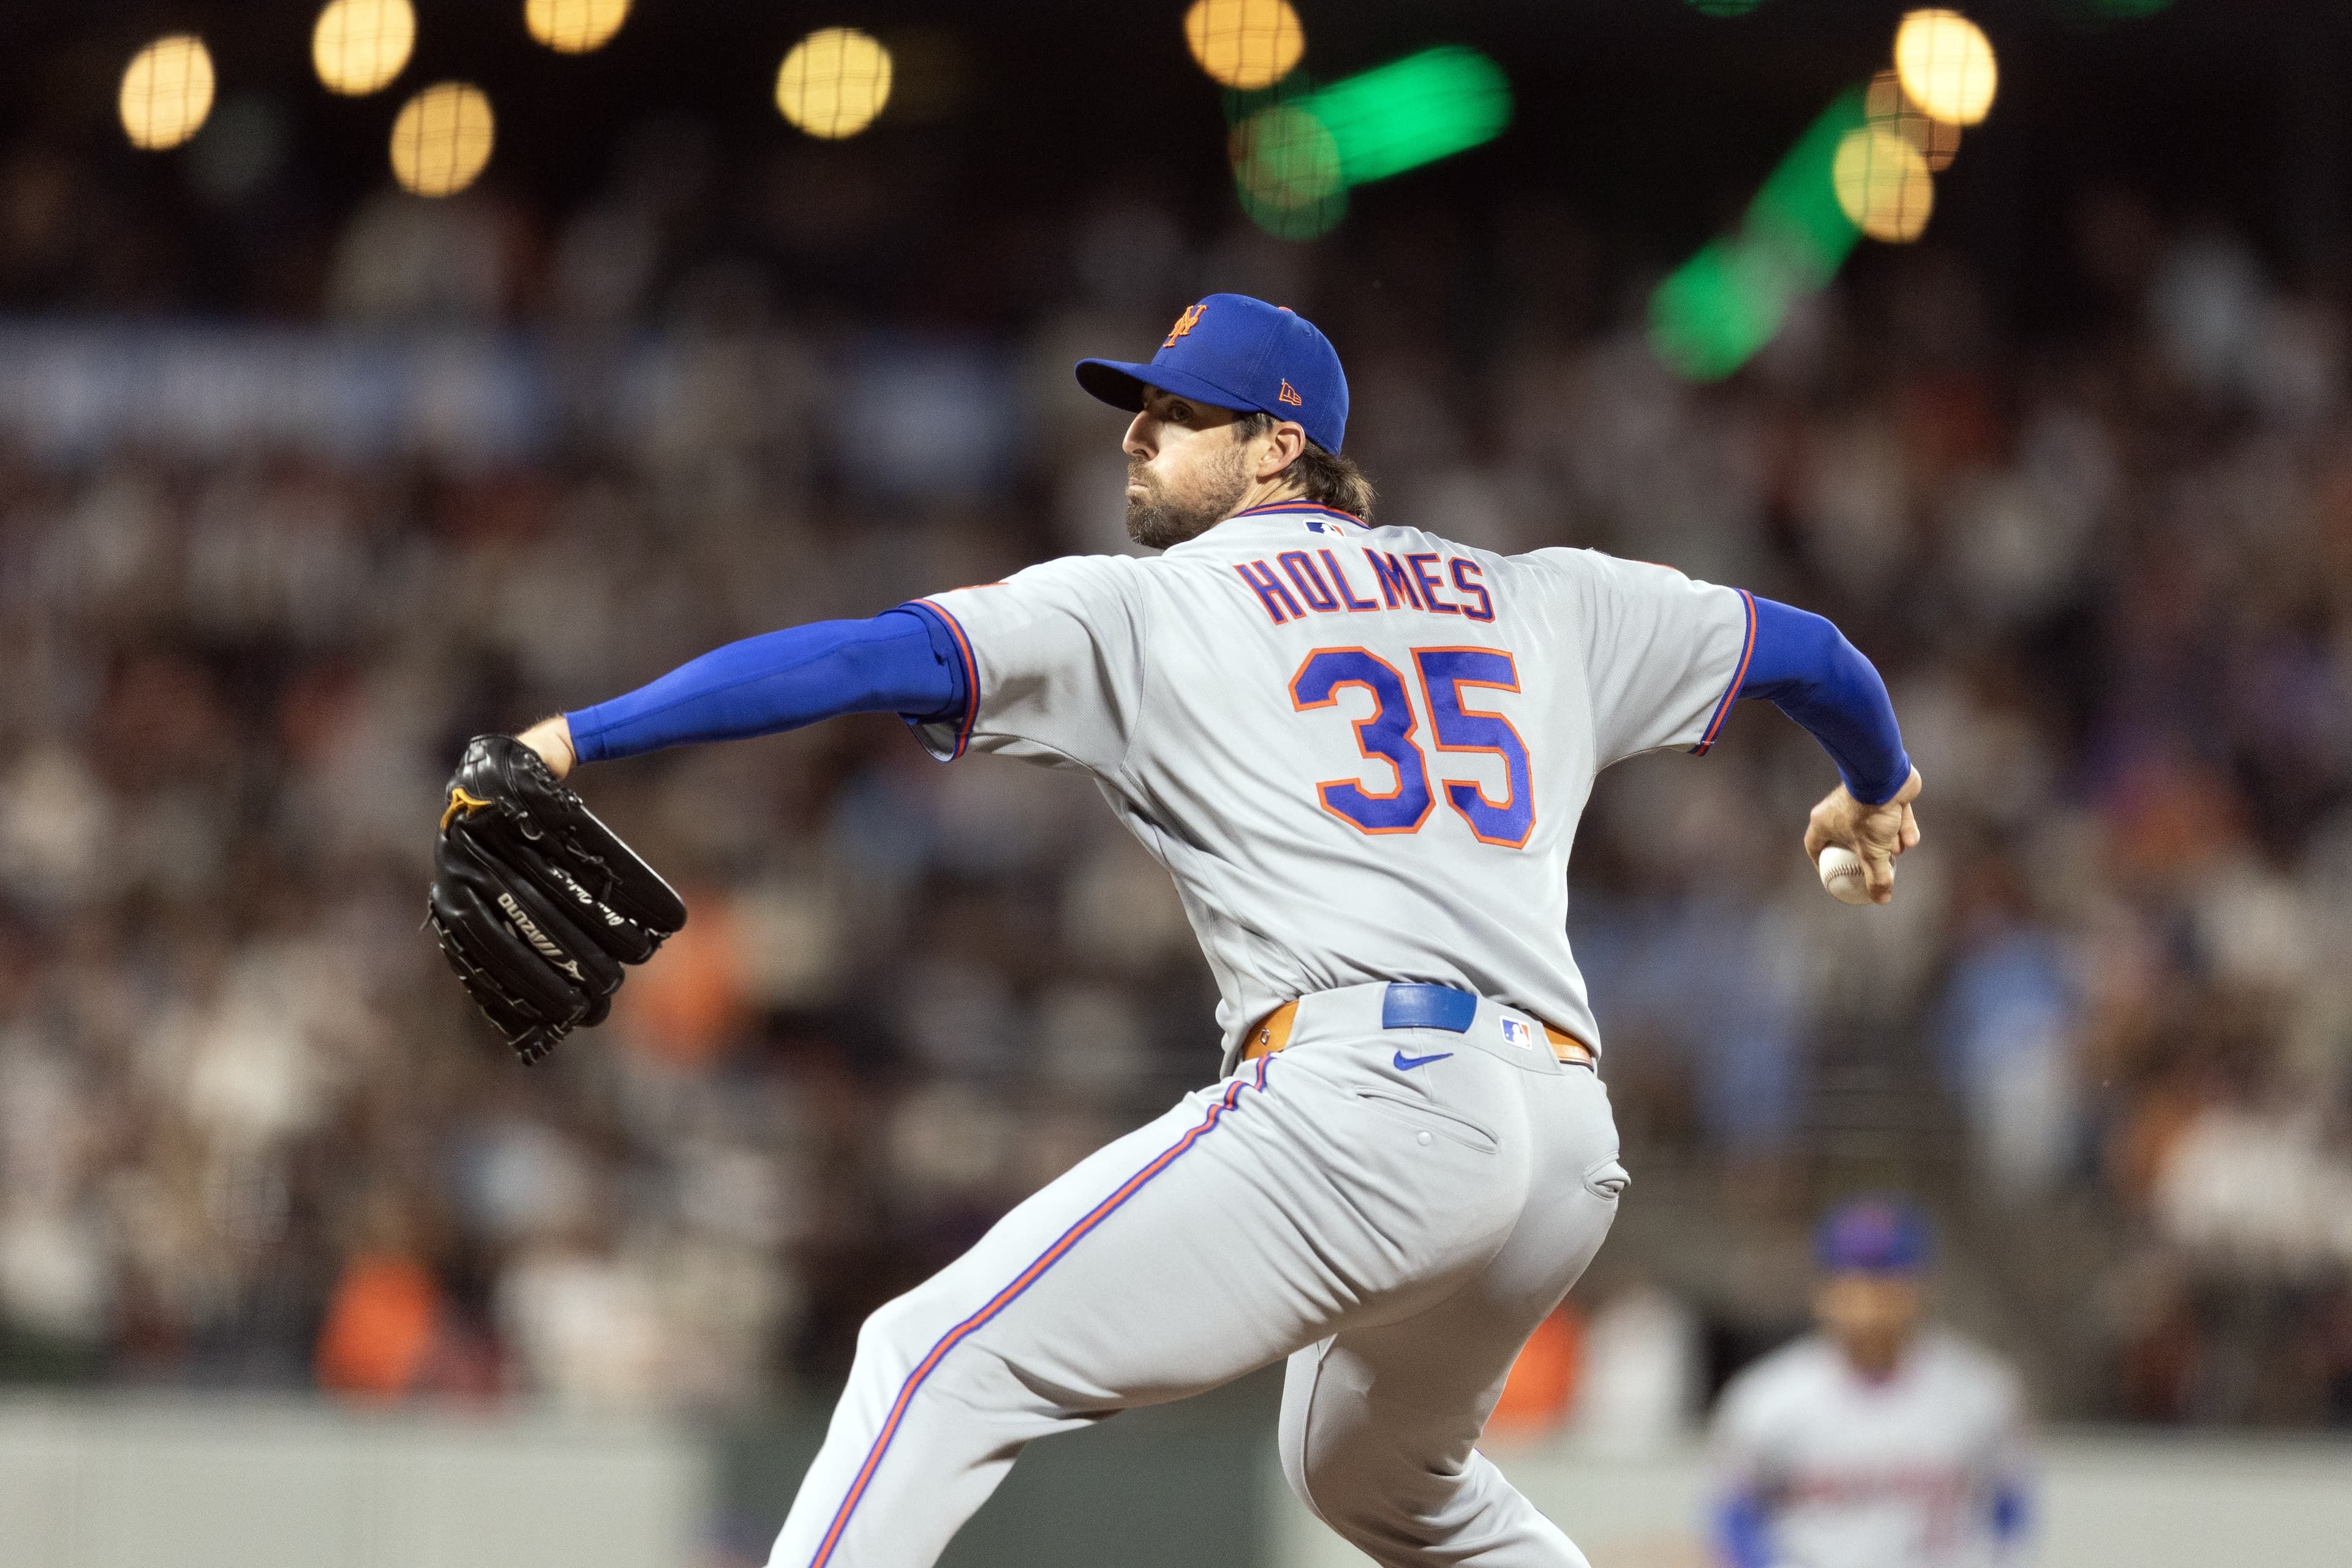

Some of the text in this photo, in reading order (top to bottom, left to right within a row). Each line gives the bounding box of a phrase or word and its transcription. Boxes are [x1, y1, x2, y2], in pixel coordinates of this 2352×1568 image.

[1233, 547, 1496, 625] HOLMES
[1287, 646, 1536, 850] 35
[497, 892, 564, 956] MIZUNO
